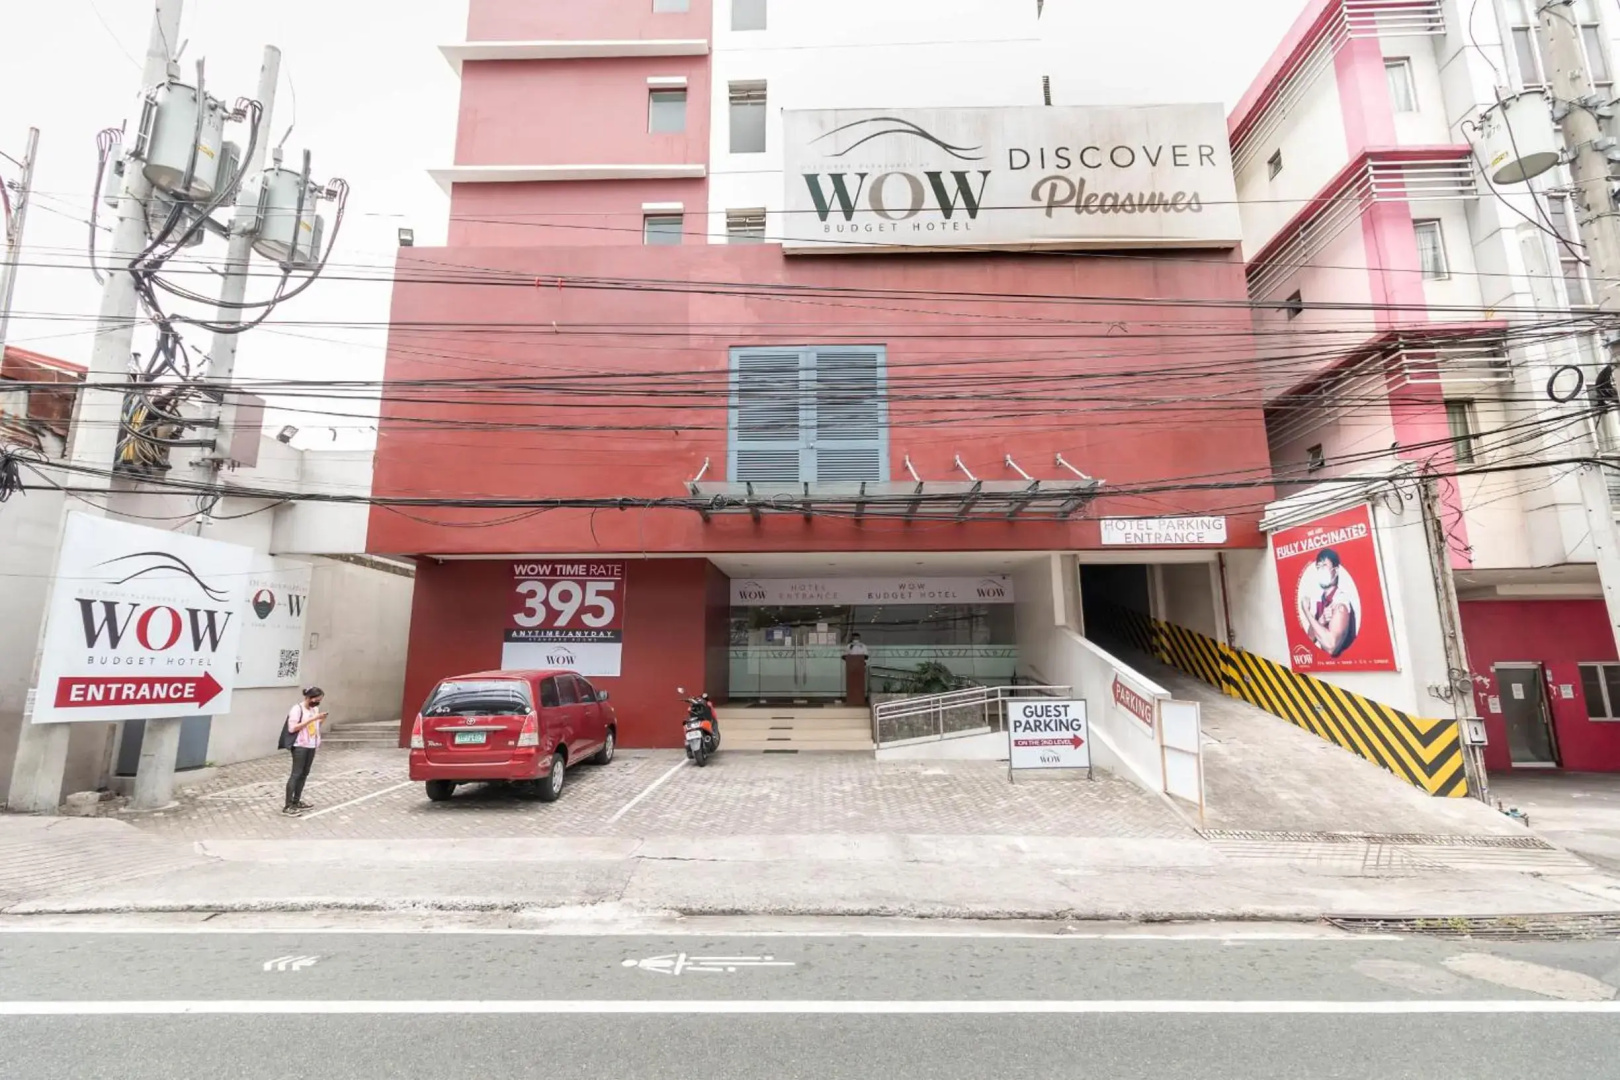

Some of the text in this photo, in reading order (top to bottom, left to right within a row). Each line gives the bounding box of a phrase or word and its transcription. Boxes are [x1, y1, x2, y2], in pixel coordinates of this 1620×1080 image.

[1008, 144, 1216, 171] DISCOVER
[801, 170, 992, 222] WOW
[1031, 174, 1203, 219] Pleasures
[823, 221, 972, 234] BUDGET HOTEL
[1104, 518, 1223, 531] HOTEL PARKING
[1124, 532, 1205, 544] ENTRANCE
[1276, 522, 1367, 558] FULLY VACCINATED
[513, 564, 622, 576] WOW TIME RATE
[739, 590, 767, 600] WOW
[778, 591, 839, 600] ENTRANCE
[867, 591, 958, 600] BUDGET HOTEL
[976, 588, 1006, 598] WOW
[513, 580, 615, 628] 395
[74, 597, 234, 653] WOW
[511, 630, 613, 638] ANYTIME/ANYDAY
[87, 655, 212, 667] BUDGET HOTEL
[546, 654, 576, 665] WOW
[1292, 653, 1314, 665] WOW
[69, 682, 197, 702] ENTRANCE
[1116, 682, 1152, 724] PARKING
[1022, 704, 1070, 719] GUEST
[1013, 718, 1082, 733] PARKING
[1040, 754, 1061, 764] WOW
